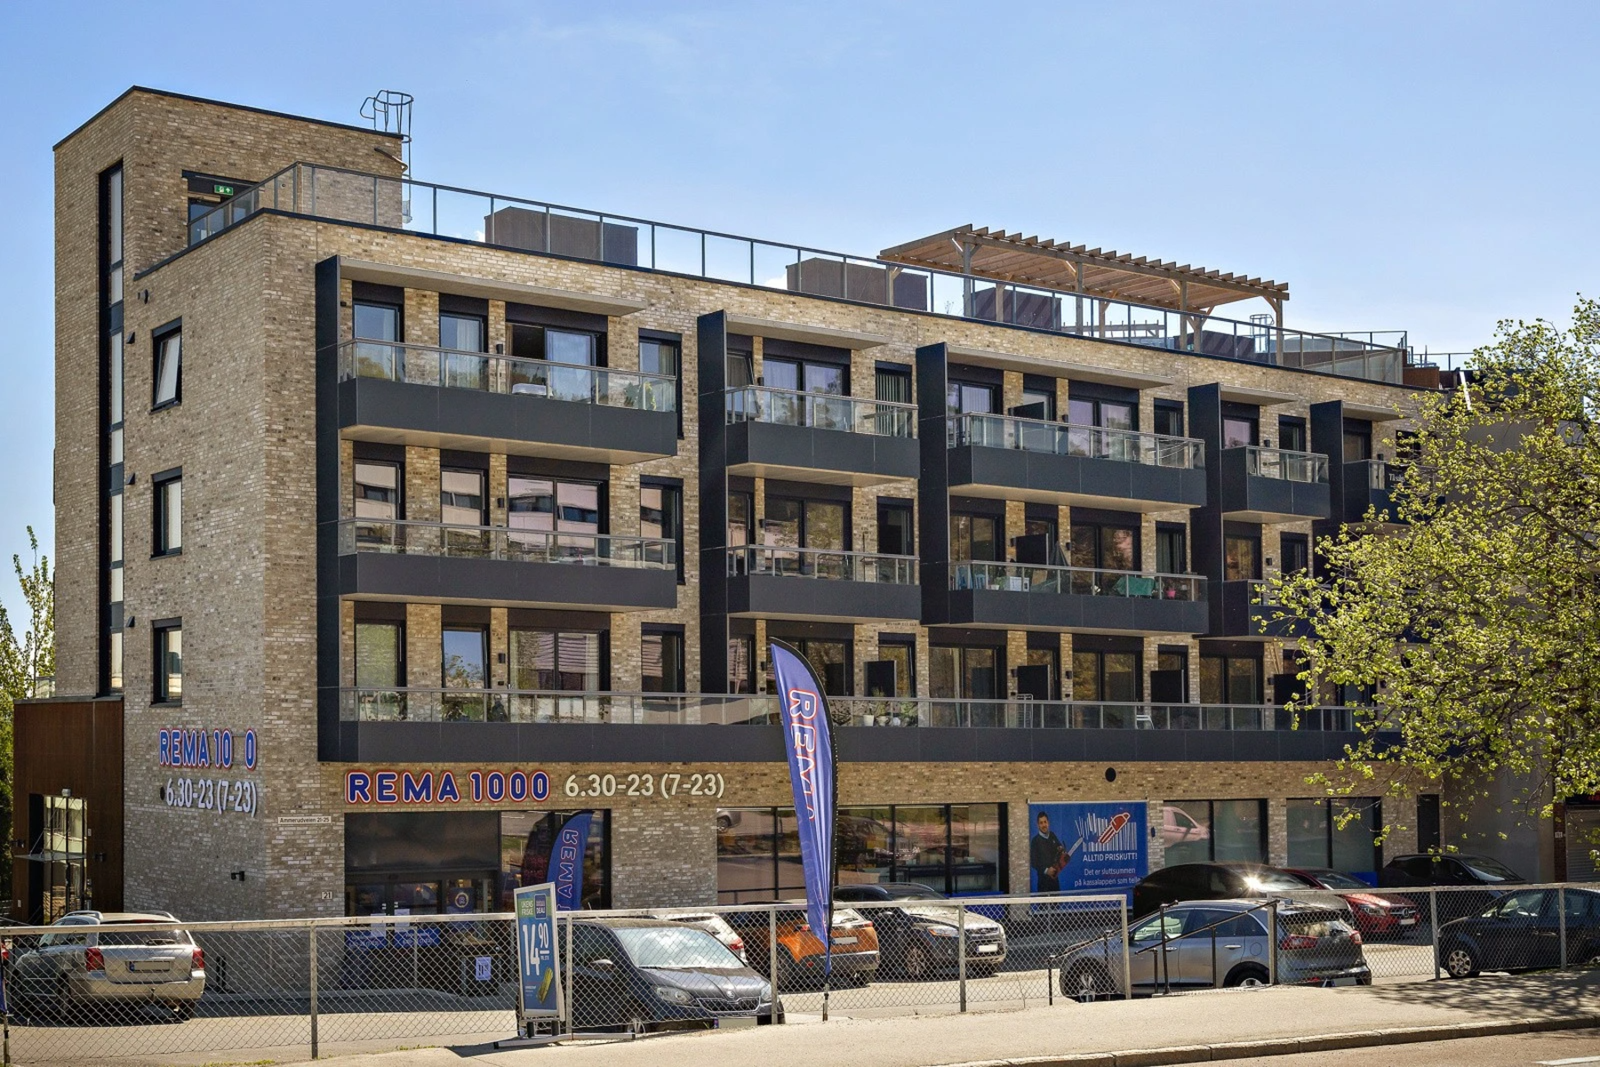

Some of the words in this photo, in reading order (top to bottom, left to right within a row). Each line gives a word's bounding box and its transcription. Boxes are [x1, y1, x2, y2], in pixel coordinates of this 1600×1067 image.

[159, 727, 211, 769] REMA
[166, 778, 214, 810] 6.30-23
[217, 779, 257, 818] (7-23)
[345, 770, 460, 804] REMA
[469, 770, 551, 803] 1000
[565, 774, 654, 797] 6.30-23
[660, 773, 725, 799] (7-23)
[1083, 854, 1104, 862] ALLTID
[1105, 853, 1138, 861] PRISKUTT!
[1074, 878, 1082, 887] på
[1083, 877, 1117, 887] kassalappen
[1084, 868, 1095, 876] Det
[1102, 867, 1136, 875] sluttsummen
[323, 891, 331, 899] 21
[522, 924, 540, 976] 14
[538, 922, 549, 949] 90
